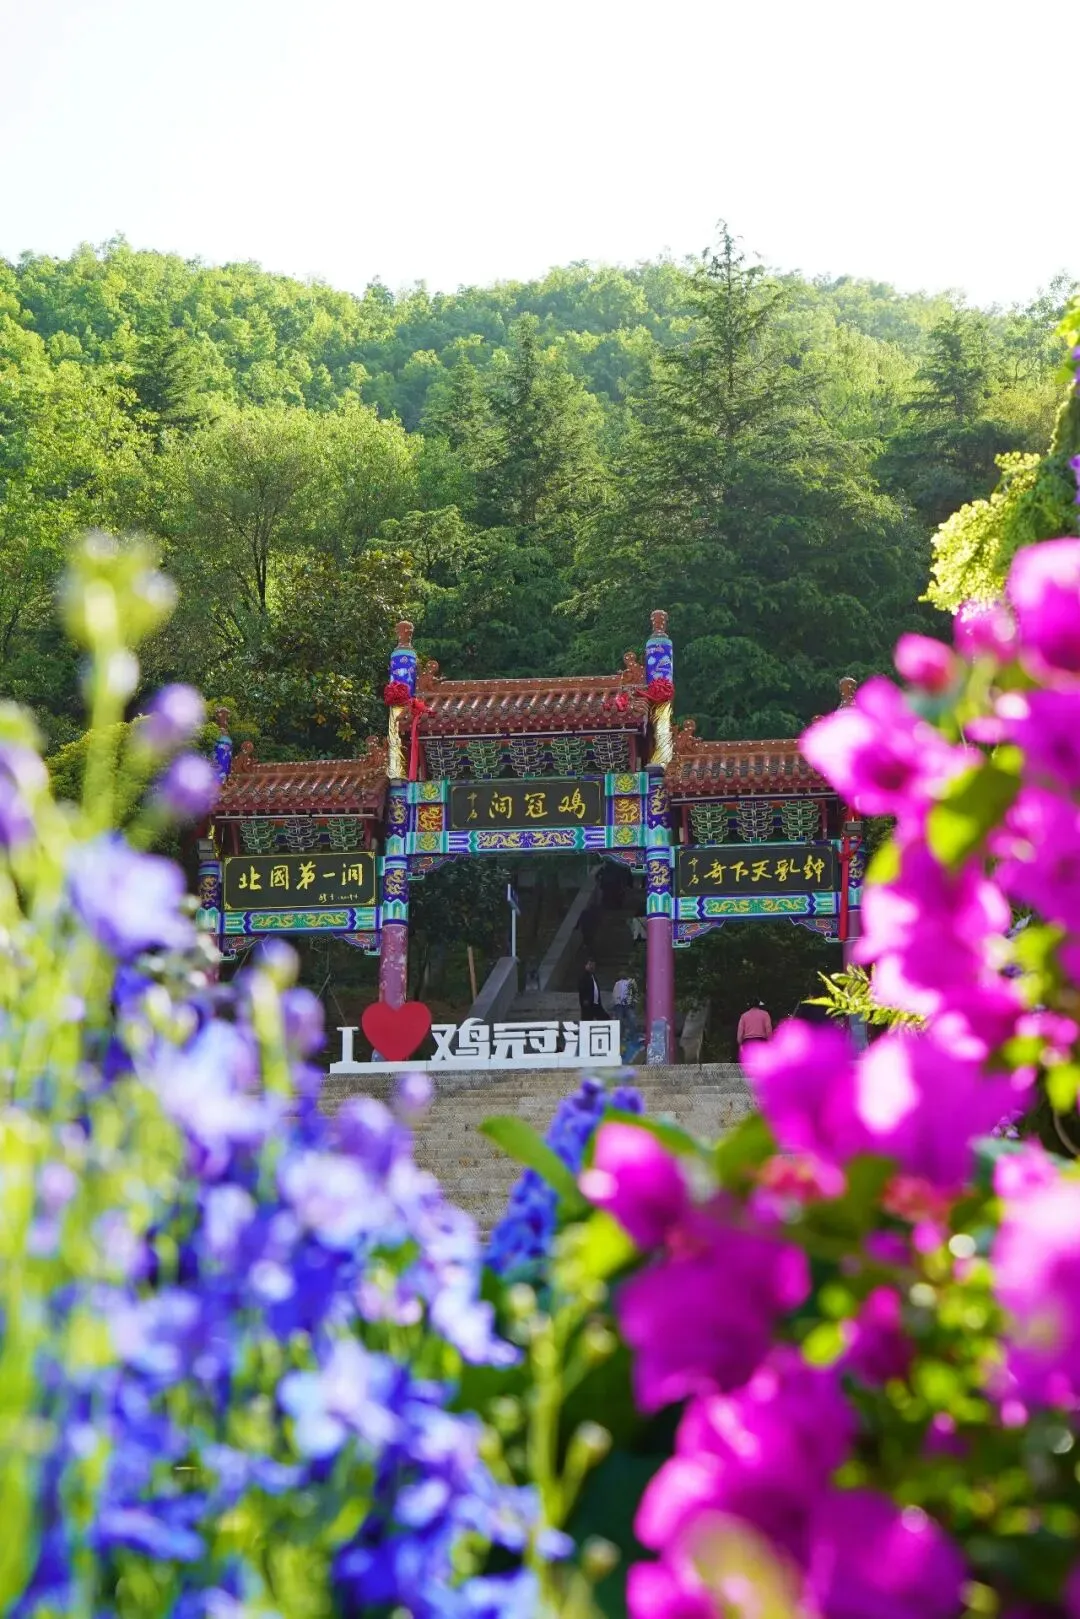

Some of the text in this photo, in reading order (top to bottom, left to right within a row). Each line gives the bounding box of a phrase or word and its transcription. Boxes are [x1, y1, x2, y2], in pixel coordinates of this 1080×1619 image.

[336, 1017, 620, 1064] I 鸡冠洞
